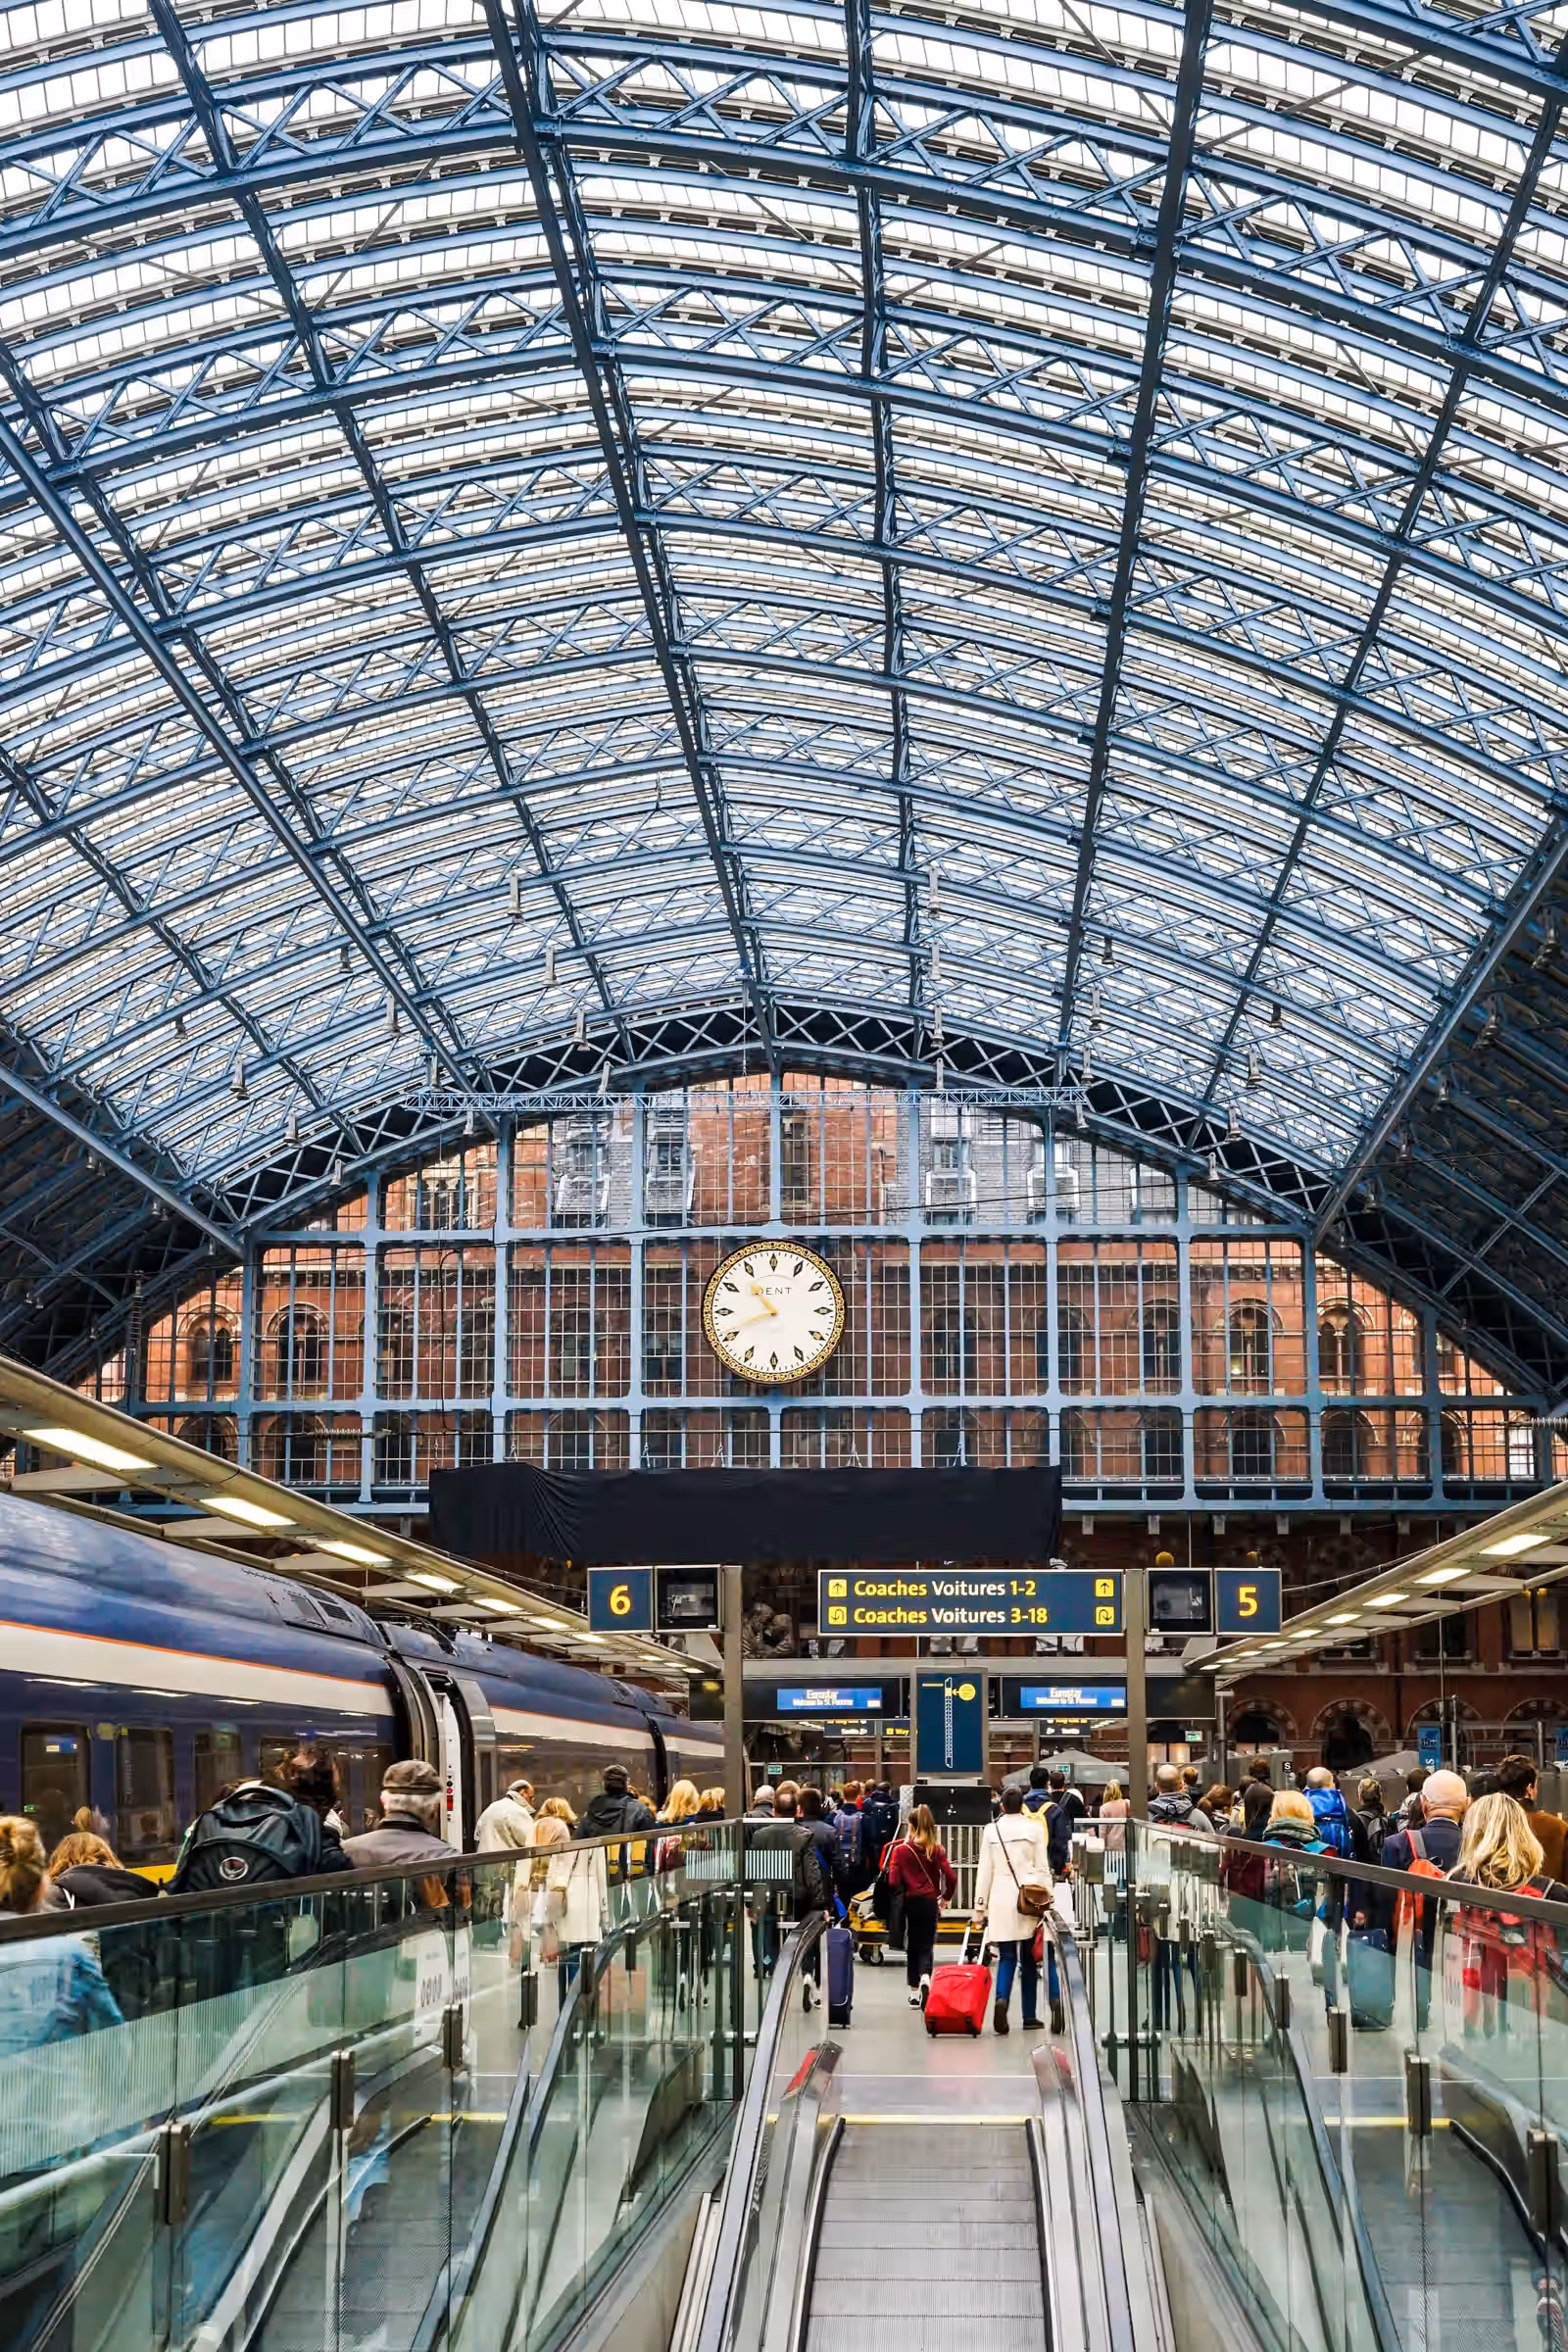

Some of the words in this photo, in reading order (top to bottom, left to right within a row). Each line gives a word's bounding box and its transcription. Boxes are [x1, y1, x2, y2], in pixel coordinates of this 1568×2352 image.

[854, 1579, 927, 1596] Coaches
[931, 1580, 1005, 1596] Voitures
[1009, 1580, 1036, 1596] 1-2
[610, 1585, 631, 1615] 6
[1239, 1585, 1258, 1617] 5
[854, 1606, 927, 1624] Coaches
[931, 1607, 1005, 1624] Voitures
[1010, 1607, 1048, 1624] 3-18
